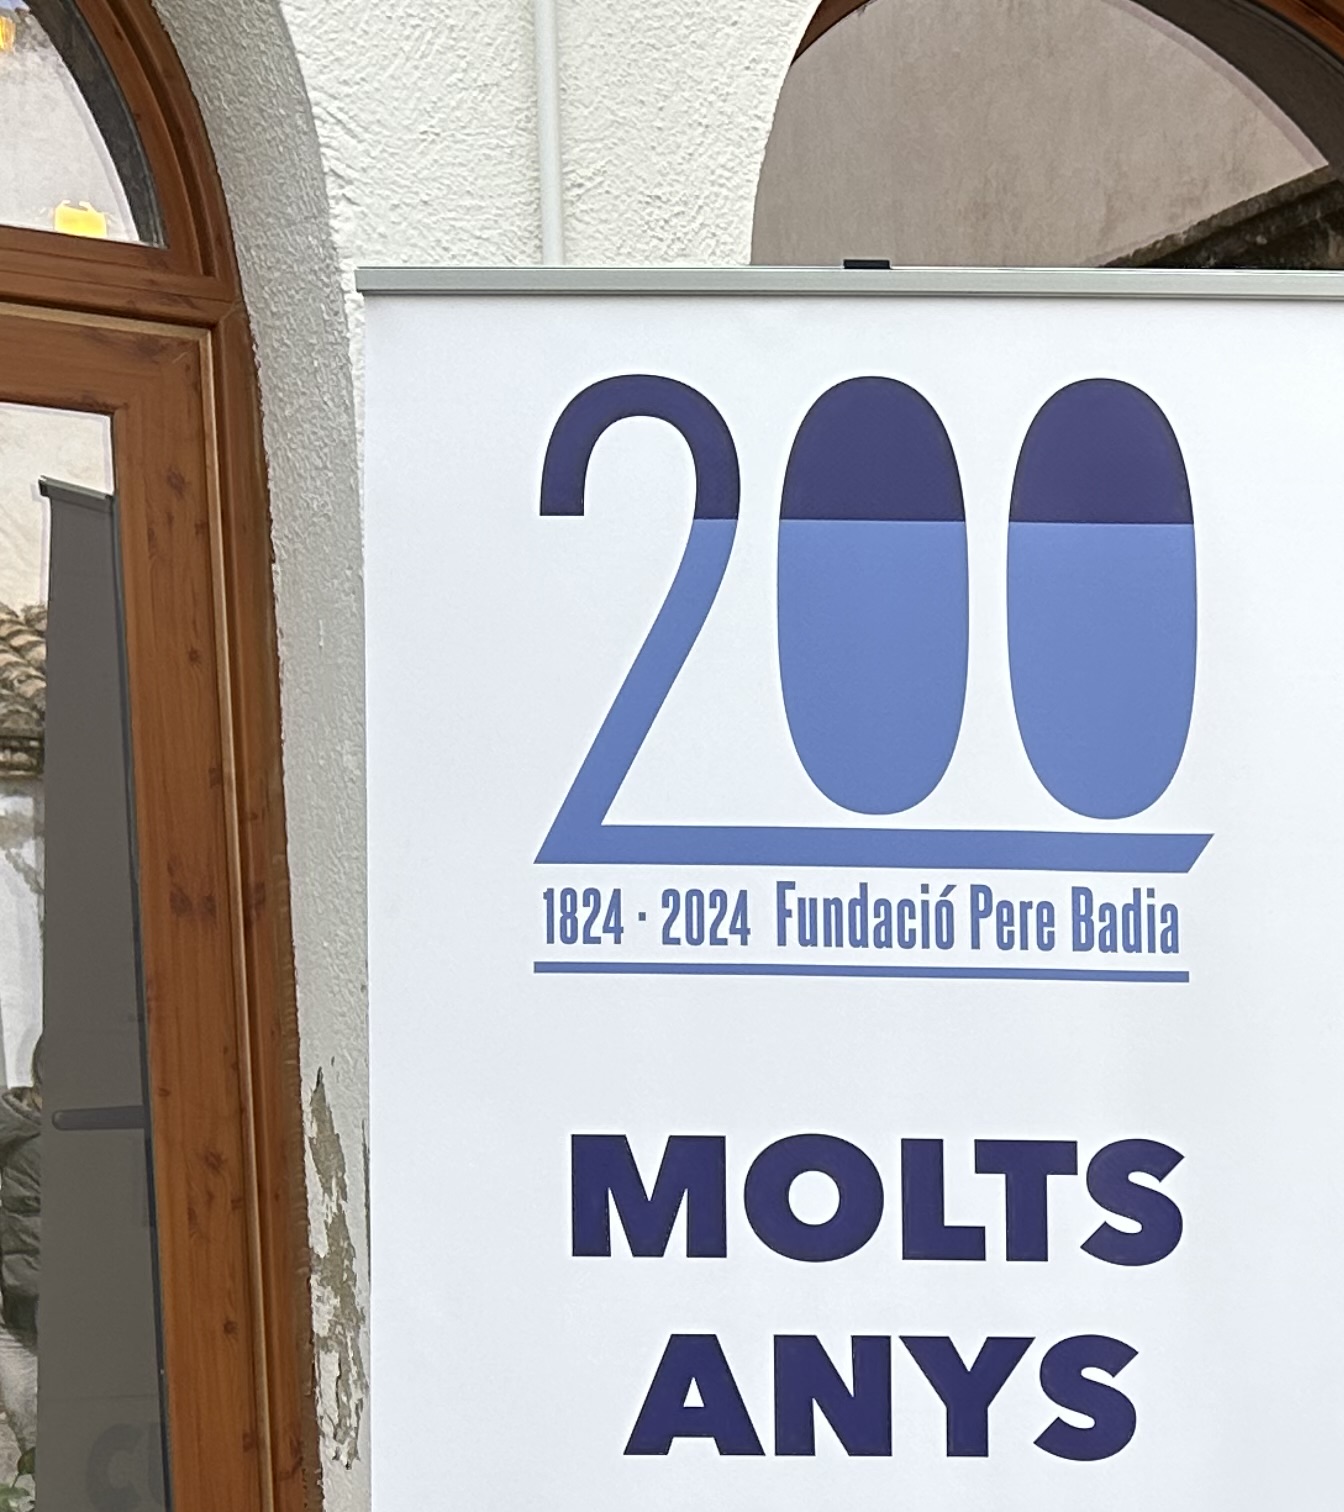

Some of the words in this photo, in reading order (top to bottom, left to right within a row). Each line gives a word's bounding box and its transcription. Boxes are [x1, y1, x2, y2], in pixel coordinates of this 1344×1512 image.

[533, 374, 1214, 873] 200
[543, 887, 624, 945] 1824
[661, 889, 751, 947] 2024
[776, 880, 957, 951] Fundació
[970, 884, 1056, 951] Pere
[1071, 886, 1180, 954] Badia
[571, 1133, 1185, 1266] MOLTS
[623, 1334, 1139, 1462] ANYS
